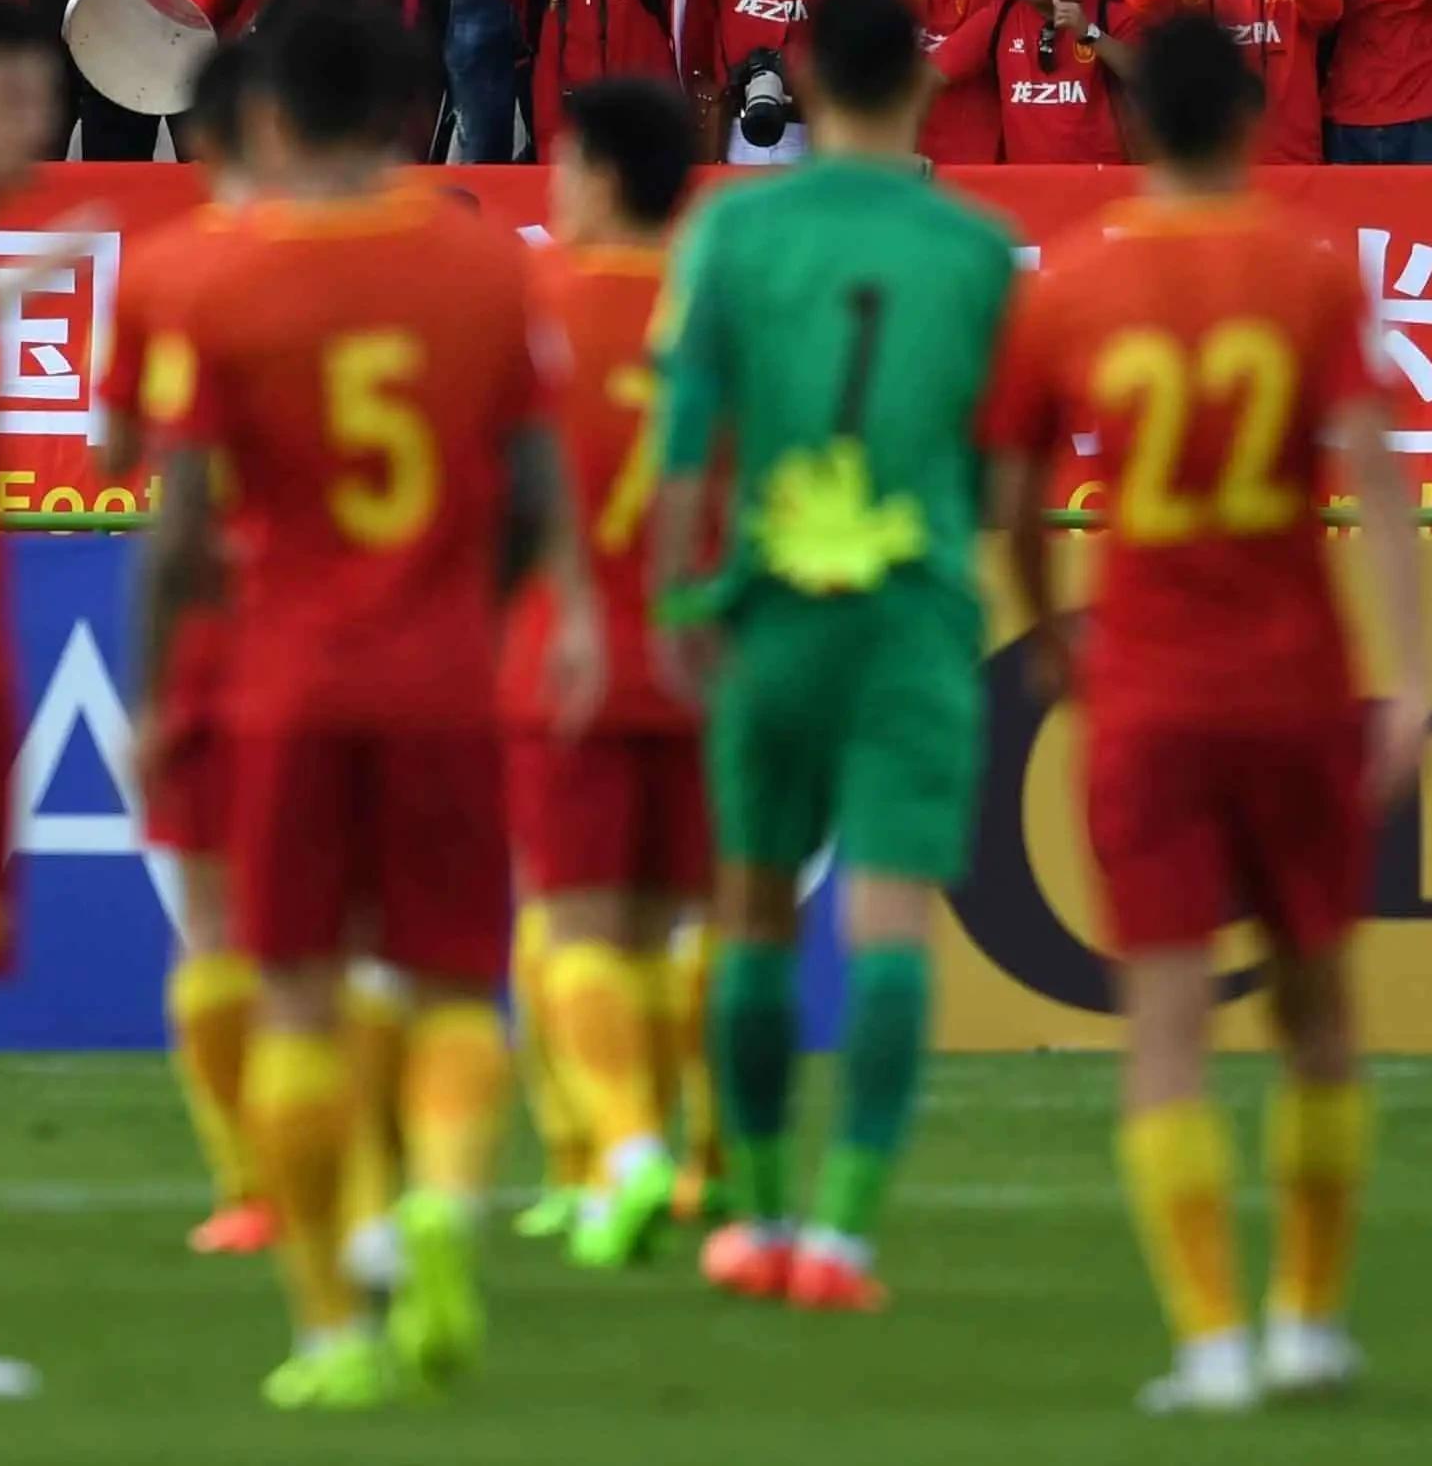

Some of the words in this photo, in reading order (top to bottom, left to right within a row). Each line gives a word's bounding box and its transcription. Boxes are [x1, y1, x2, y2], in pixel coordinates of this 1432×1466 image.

[1010, 80, 1088, 105] 龙之队
[1235, 21, 1282, 46] 之队
[323, 330, 443, 548] 5
[1090, 318, 1303, 548] 22
